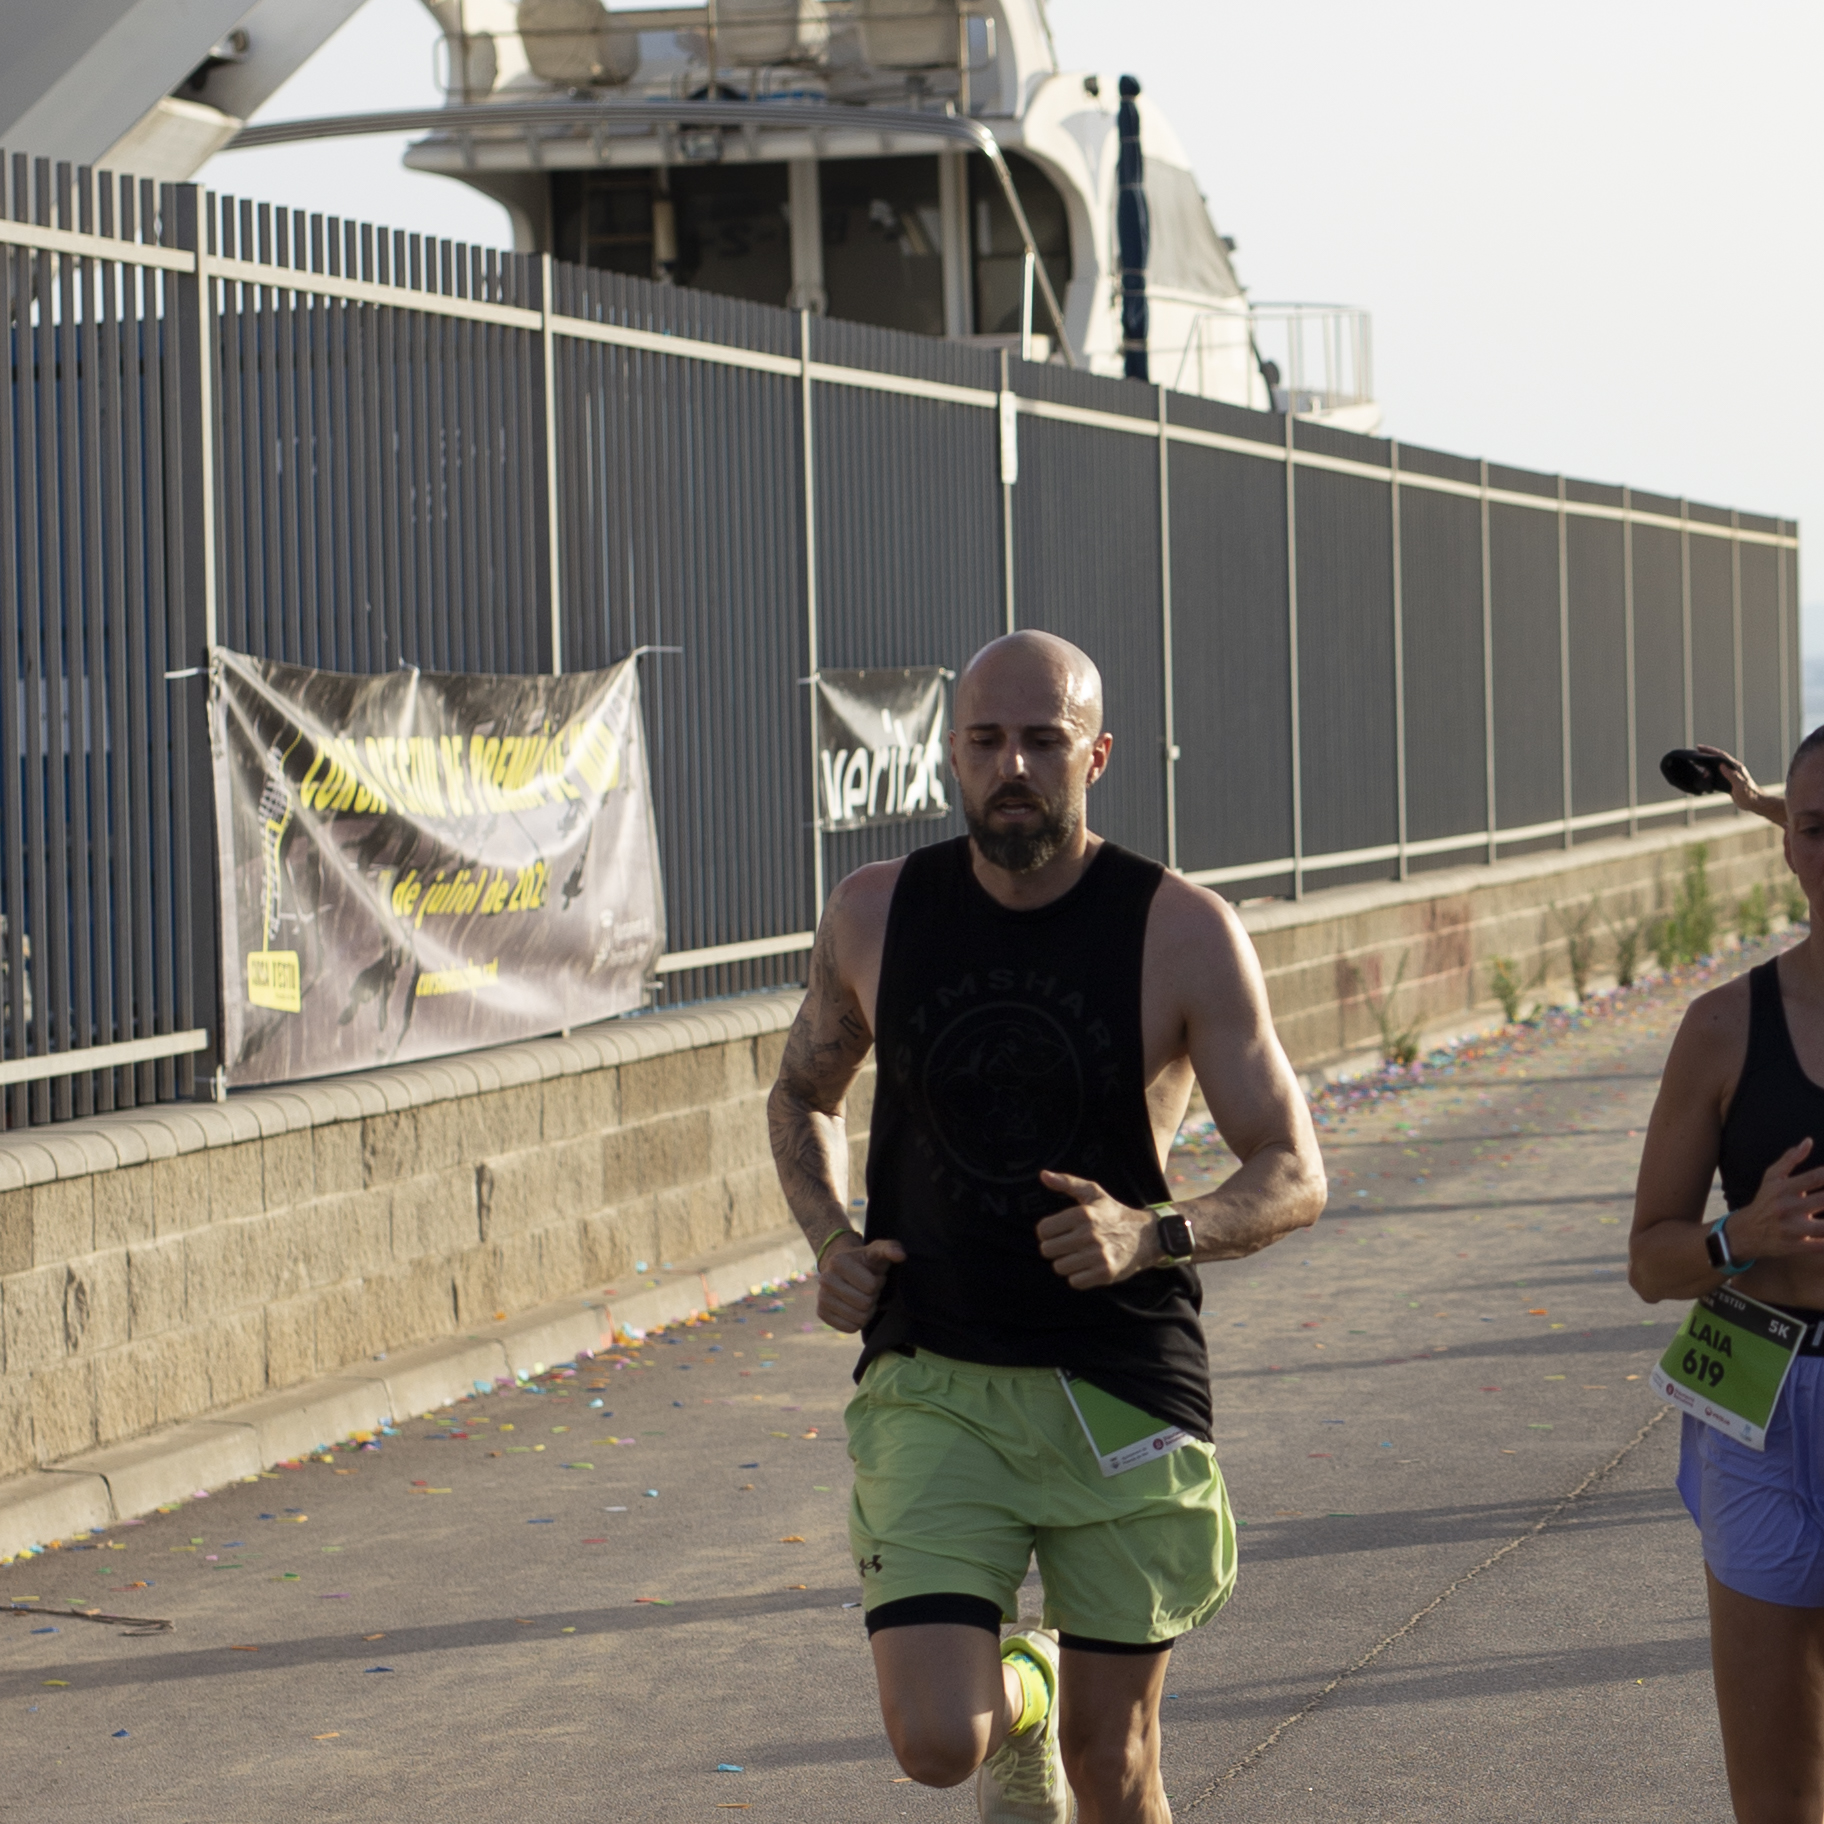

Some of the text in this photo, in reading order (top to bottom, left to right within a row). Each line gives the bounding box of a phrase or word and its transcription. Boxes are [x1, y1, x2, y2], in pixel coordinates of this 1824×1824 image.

[392, 869, 422, 917] de
[414, 868, 489, 929] juliol
[481, 866, 510, 915] de
[507, 861, 549, 913] 202
[893, 967, 1121, 1097] GYMSHARK
[1688, 1315, 1733, 1359] LAIA
[1767, 1319, 1791, 1341] 5K
[1682, 1347, 1725, 1388] 619
